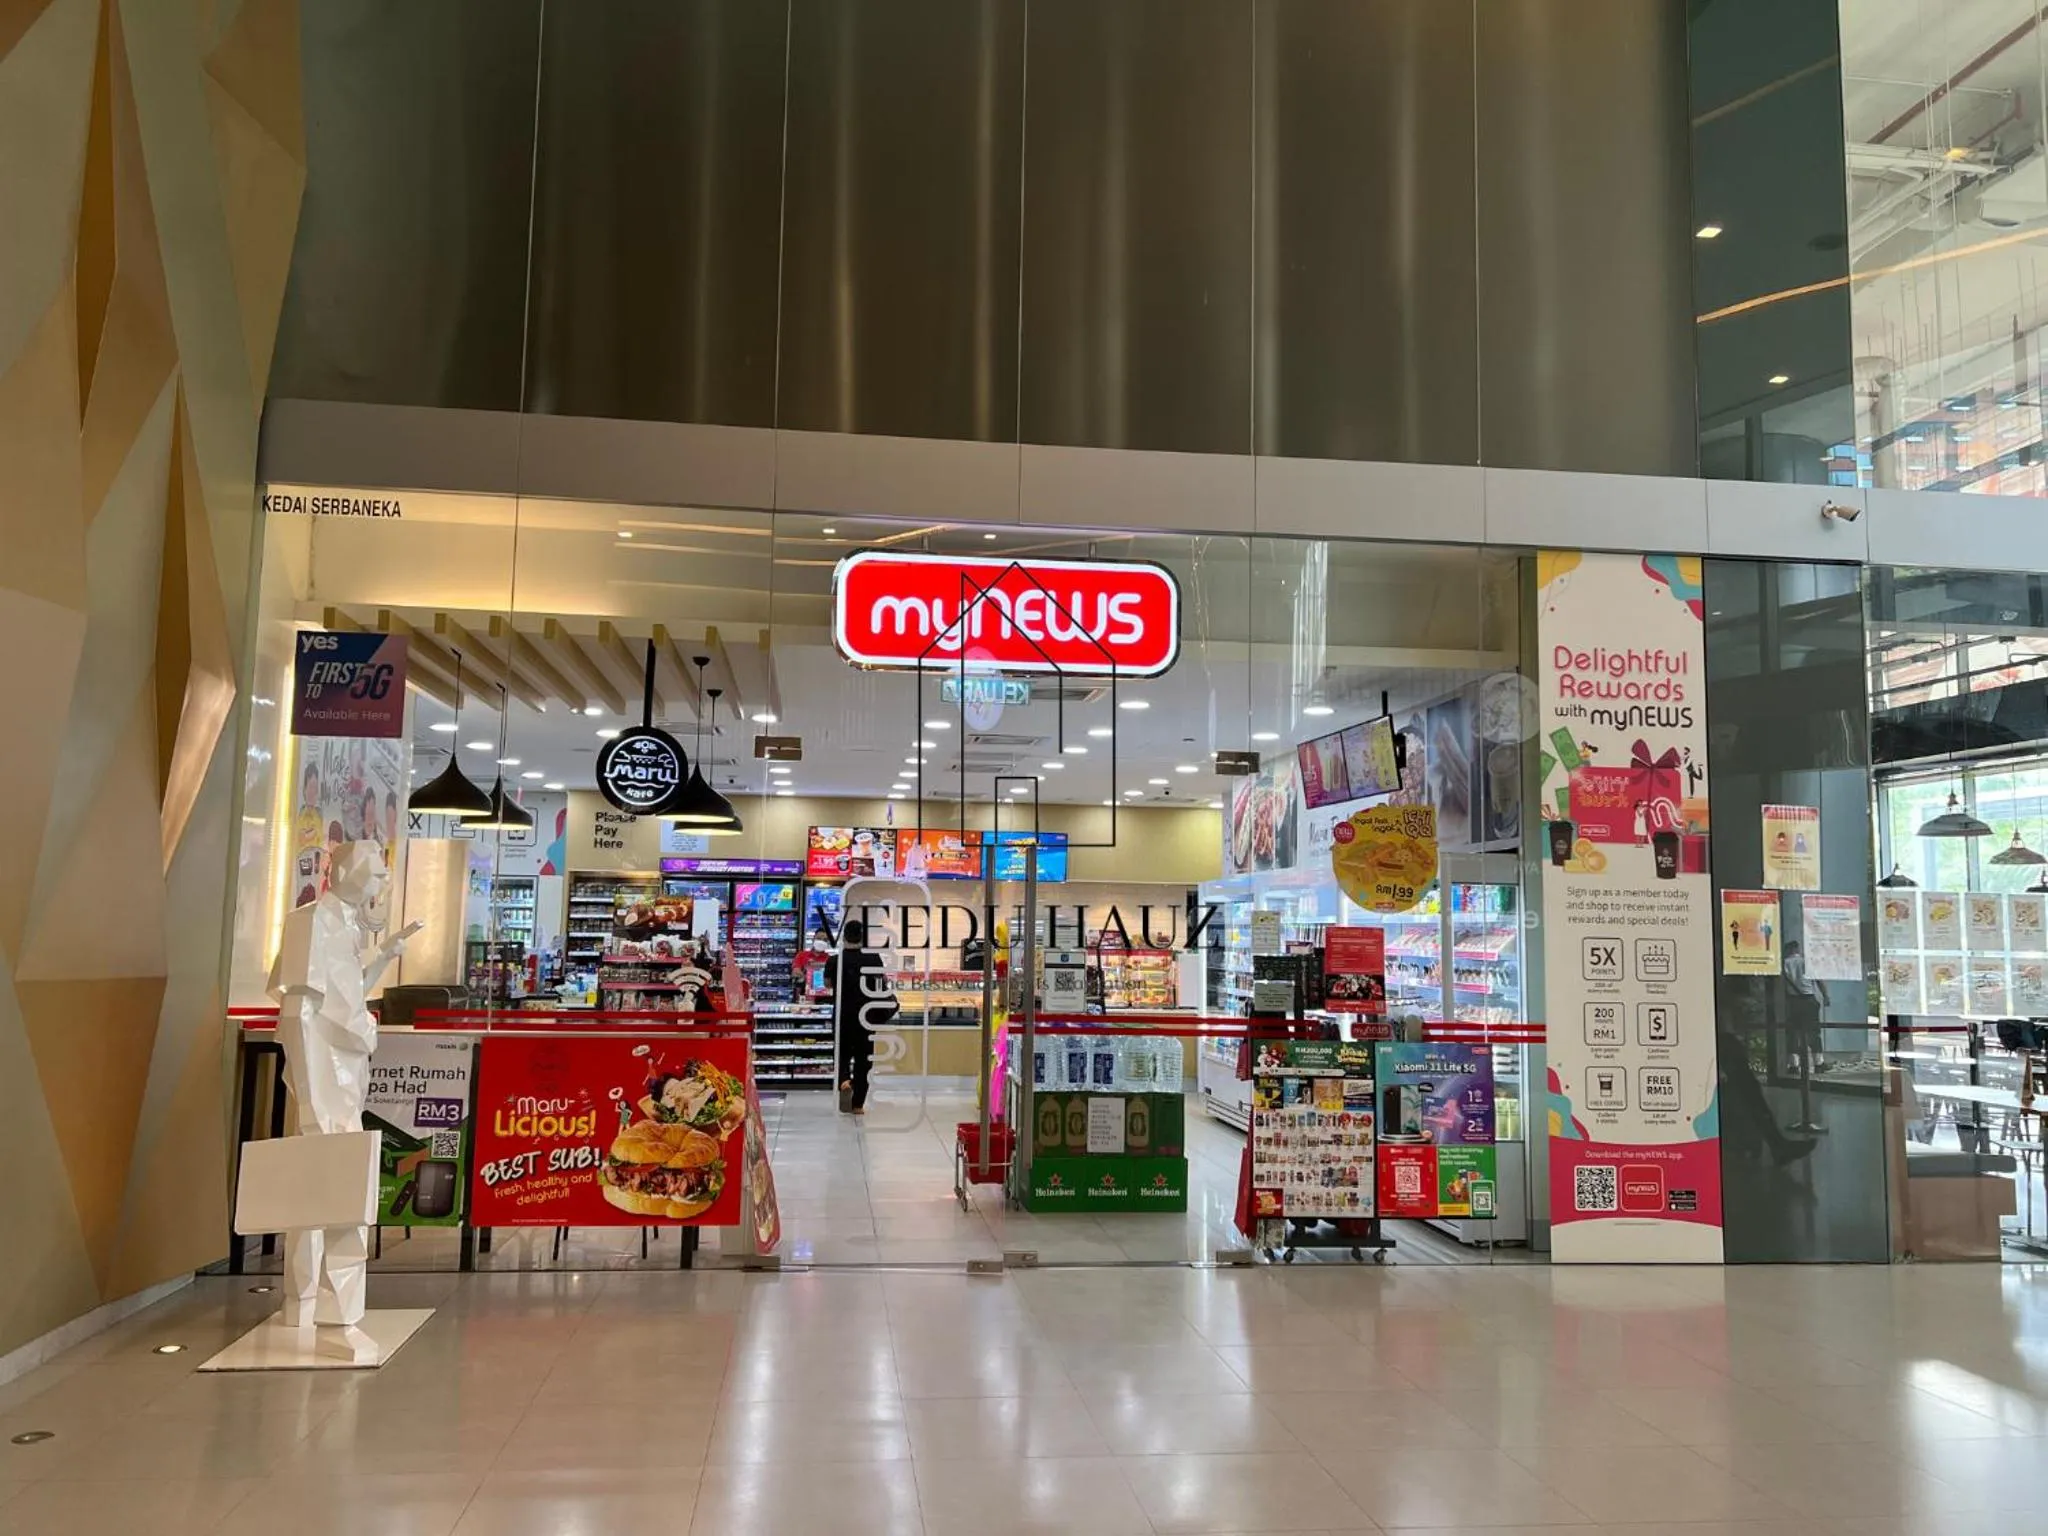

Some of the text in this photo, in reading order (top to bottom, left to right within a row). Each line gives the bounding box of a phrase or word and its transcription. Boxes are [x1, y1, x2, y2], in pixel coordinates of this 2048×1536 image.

[262, 495, 402, 517] KEDAI SERBANEKA
[301, 635, 338, 653] yes
[1554, 645, 1687, 678] Delightful
[309, 662, 394, 700] FIRST 5G
[1560, 673, 1684, 702] Rewards
[305, 683, 323, 699] TO
[304, 708, 391, 720] Available Here
[1555, 704, 1587, 717] with
[594, 824, 618, 837] Pay
[593, 838, 623, 848] Here
[1567, 886, 1689, 900] Sign up as a member today
[1566, 901, 1689, 912] and shop to receive instant
[1568, 916, 1605, 925] rewards
[1607, 916, 1625, 925] and
[1627, 916, 1660, 926] special
[1590, 947, 1616, 966] 5X
[1595, 1008, 1614, 1018] 200
[1593, 1029, 1616, 1039] RM1
[369, 1065, 466, 1081] rnet Rumah
[1394, 1062, 1429, 1072] Xiaomi
[1430, 1063, 1441, 1071] 11
[1443, 1063, 1461, 1072] Lite
[1647, 1075, 1672, 1084] FREE
[394, 1081, 427, 1094] Had
[1646, 1086, 1674, 1095] RM10
[418, 1103, 460, 1121] RM3
[517, 1096, 575, 1115] Maru-
[494, 1110, 597, 1138] Licious!
[480, 1146, 601, 1186] BEST SUB!
[494, 1173, 592, 1199] Fresh, healthy and
[1035, 1188, 1075, 1197] Heineken
[1088, 1188, 1128, 1197] Heineken
[1140, 1188, 1180, 1197] Heineken
